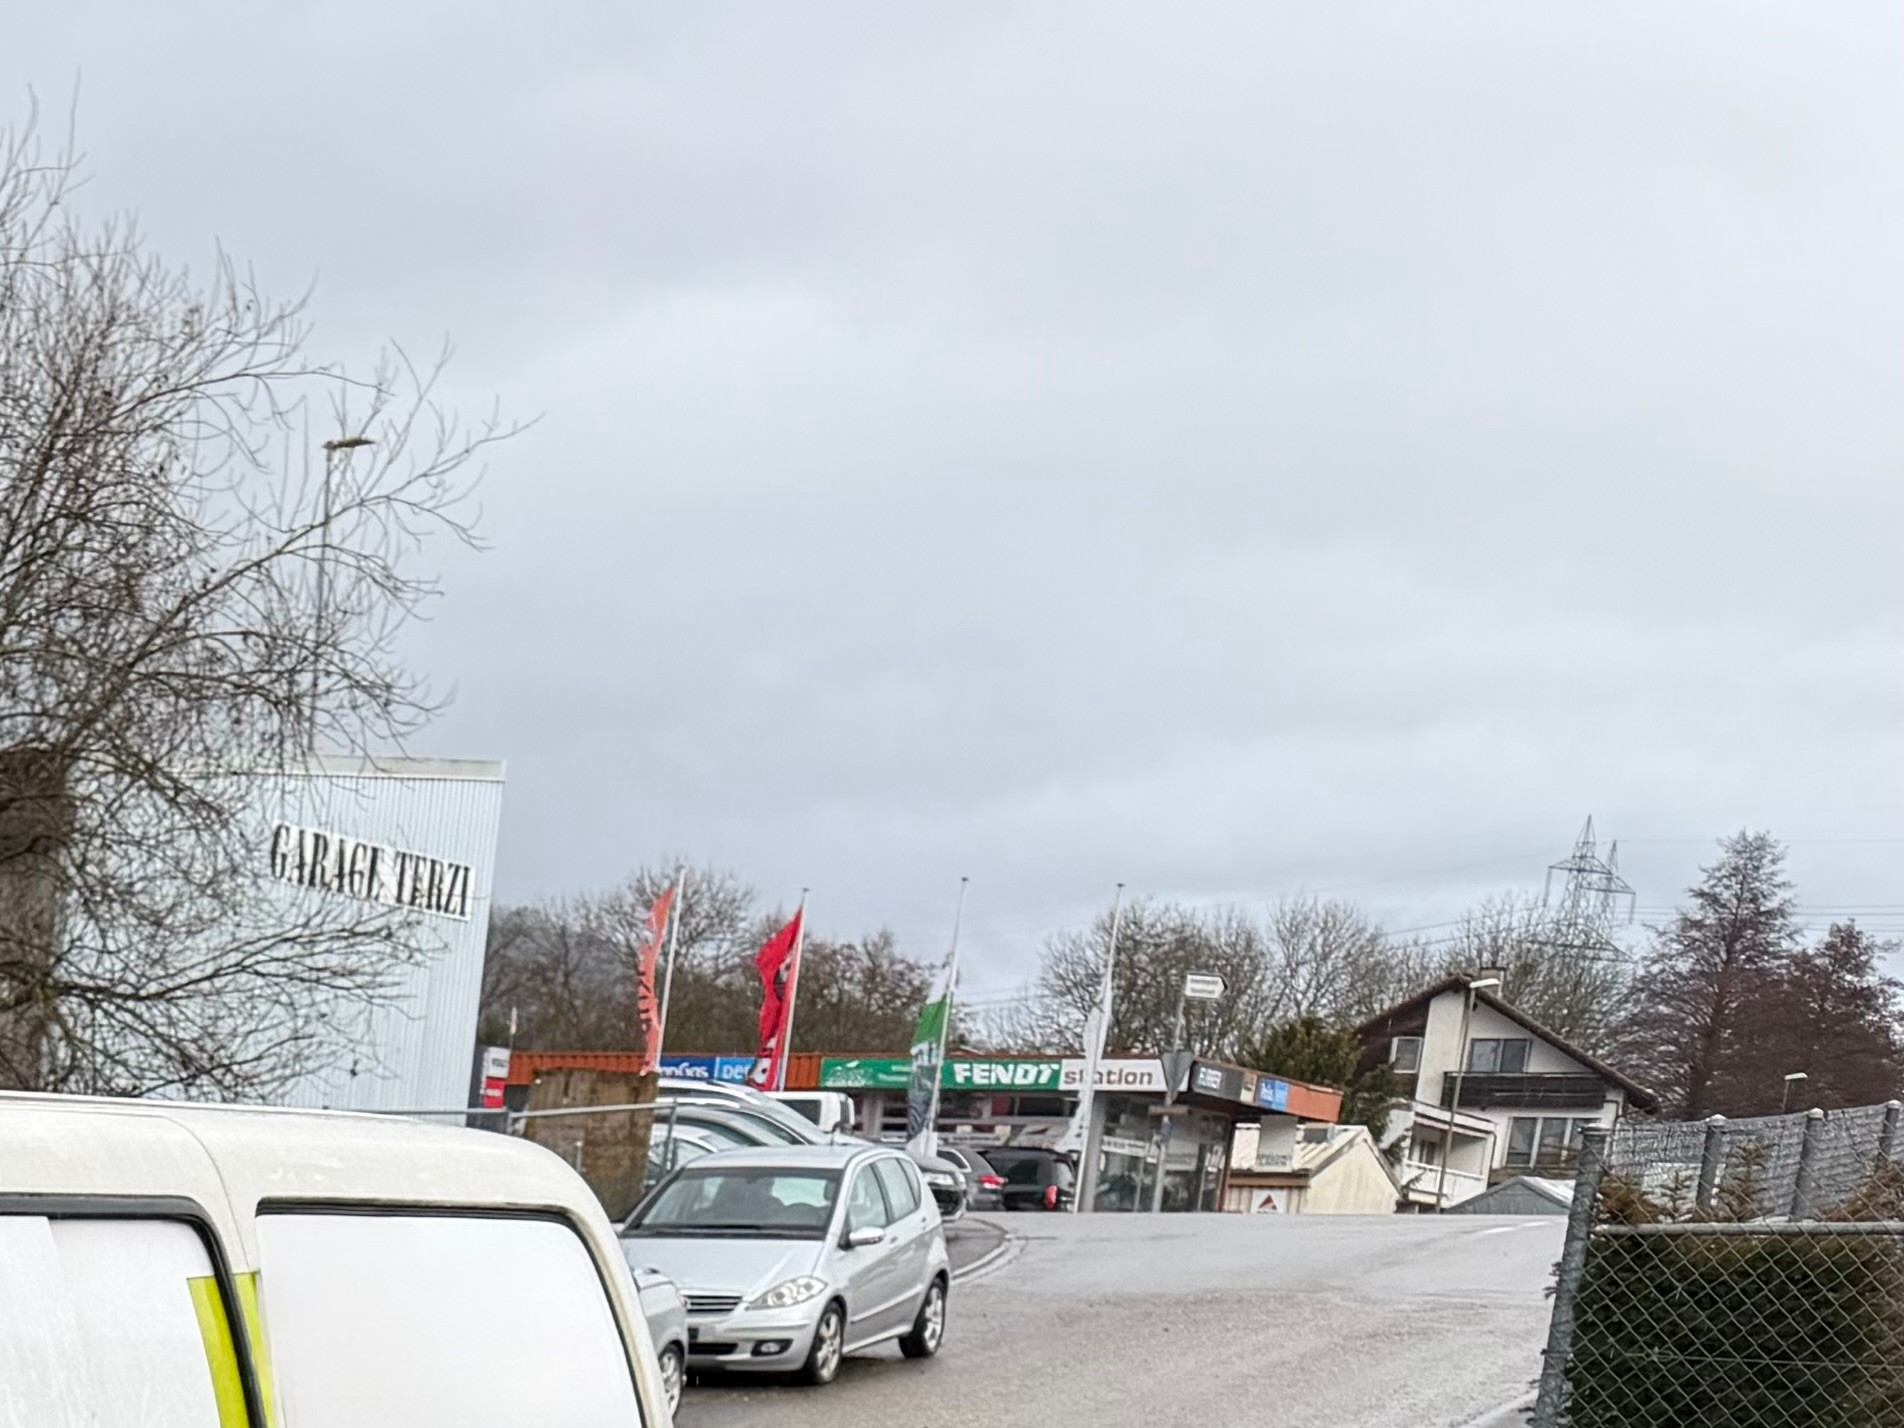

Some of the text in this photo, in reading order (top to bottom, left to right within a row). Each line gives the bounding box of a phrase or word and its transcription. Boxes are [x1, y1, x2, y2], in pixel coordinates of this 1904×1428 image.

[271, 824, 471, 917] GARAGE TERZI
[953, 1063, 1060, 1085] FENDT
